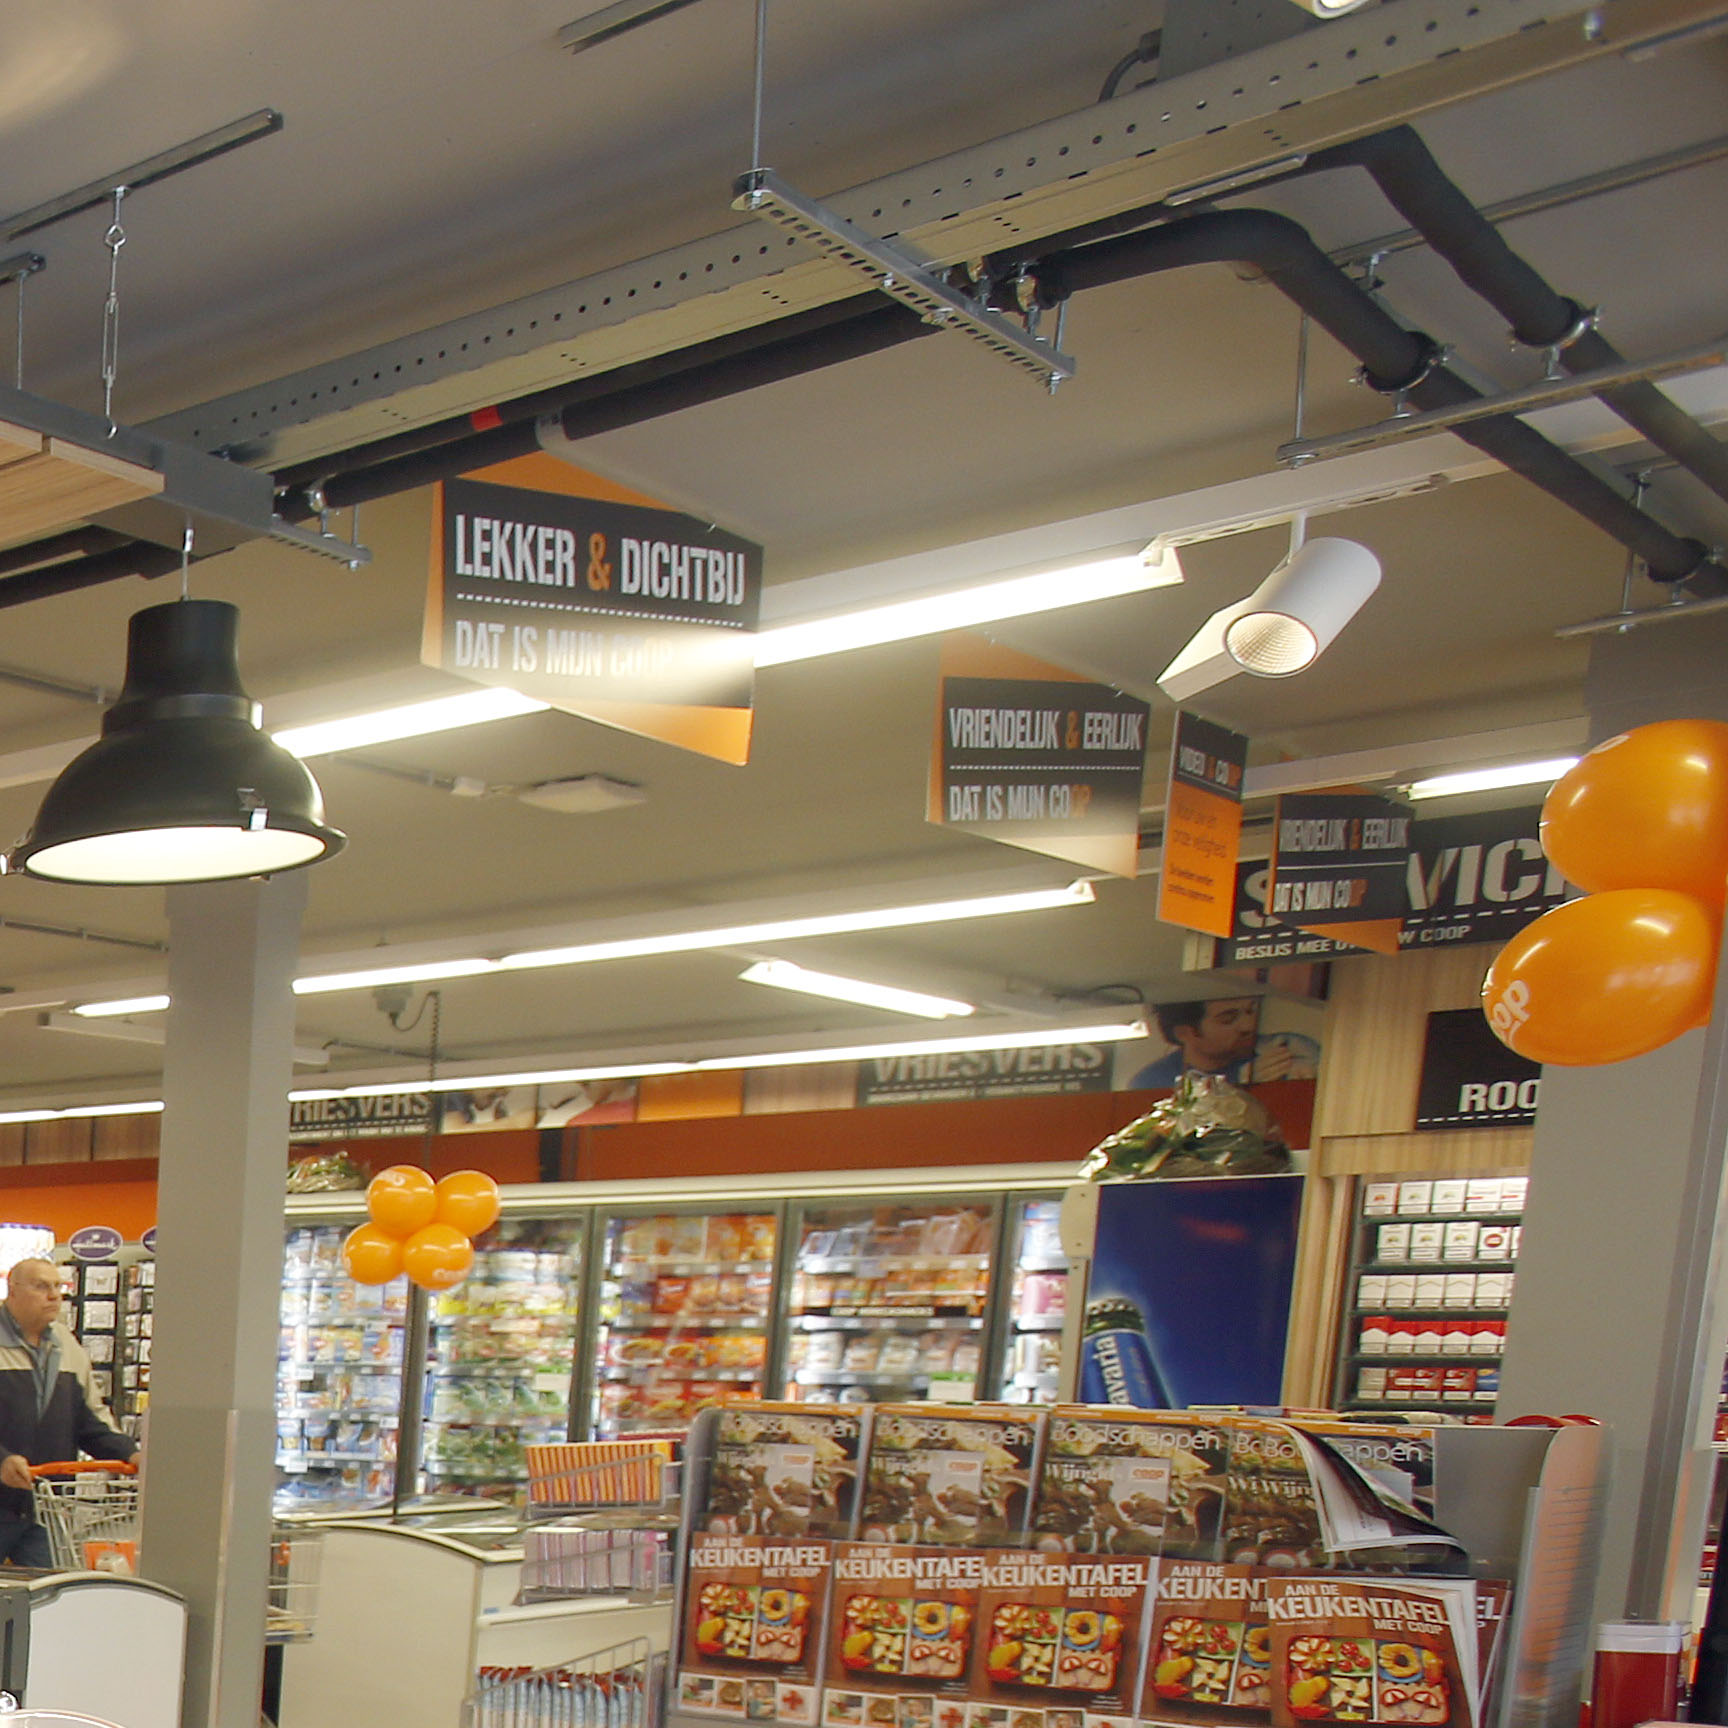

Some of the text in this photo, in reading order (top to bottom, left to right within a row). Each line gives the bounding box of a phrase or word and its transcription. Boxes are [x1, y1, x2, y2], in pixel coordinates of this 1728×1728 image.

[455, 514, 745, 606] LEKKER & DICHTBIJ
[455, 619, 506, 669] DAT
[512, 625, 539, 673] IS
[546, 628, 605, 677] MIJN
[949, 707, 1144, 750] VRIENDELIJK & EERLIJK
[949, 785, 981, 821] DAT
[986, 785, 1003, 821] IS
[1007, 785, 1045, 820] MIJN
[1363, 817, 1410, 849] EERLIJK
[1295, 938, 1332, 956] MEE
[1421, 923, 1472, 945] COOP
[703, 1538, 743, 1548] AAN DE
[689, 1546, 831, 1568] KEUKENTAFEL
[835, 1556, 986, 1579] KEUKENTAFE
[999, 1554, 1047, 1565] AAN DE
[762, 1567, 788, 1578] MET
[983, 1563, 1149, 1588] KEUKENTAFEL
[1068, 1586, 1096, 1598] MET
[1156, 1578, 1269, 1601] KEUKENT
[1285, 1583, 1340, 1596] AAN DE
[1268, 1597, 1451, 1625] KEUKENTAFEL
[1374, 1618, 1405, 1632] MET
